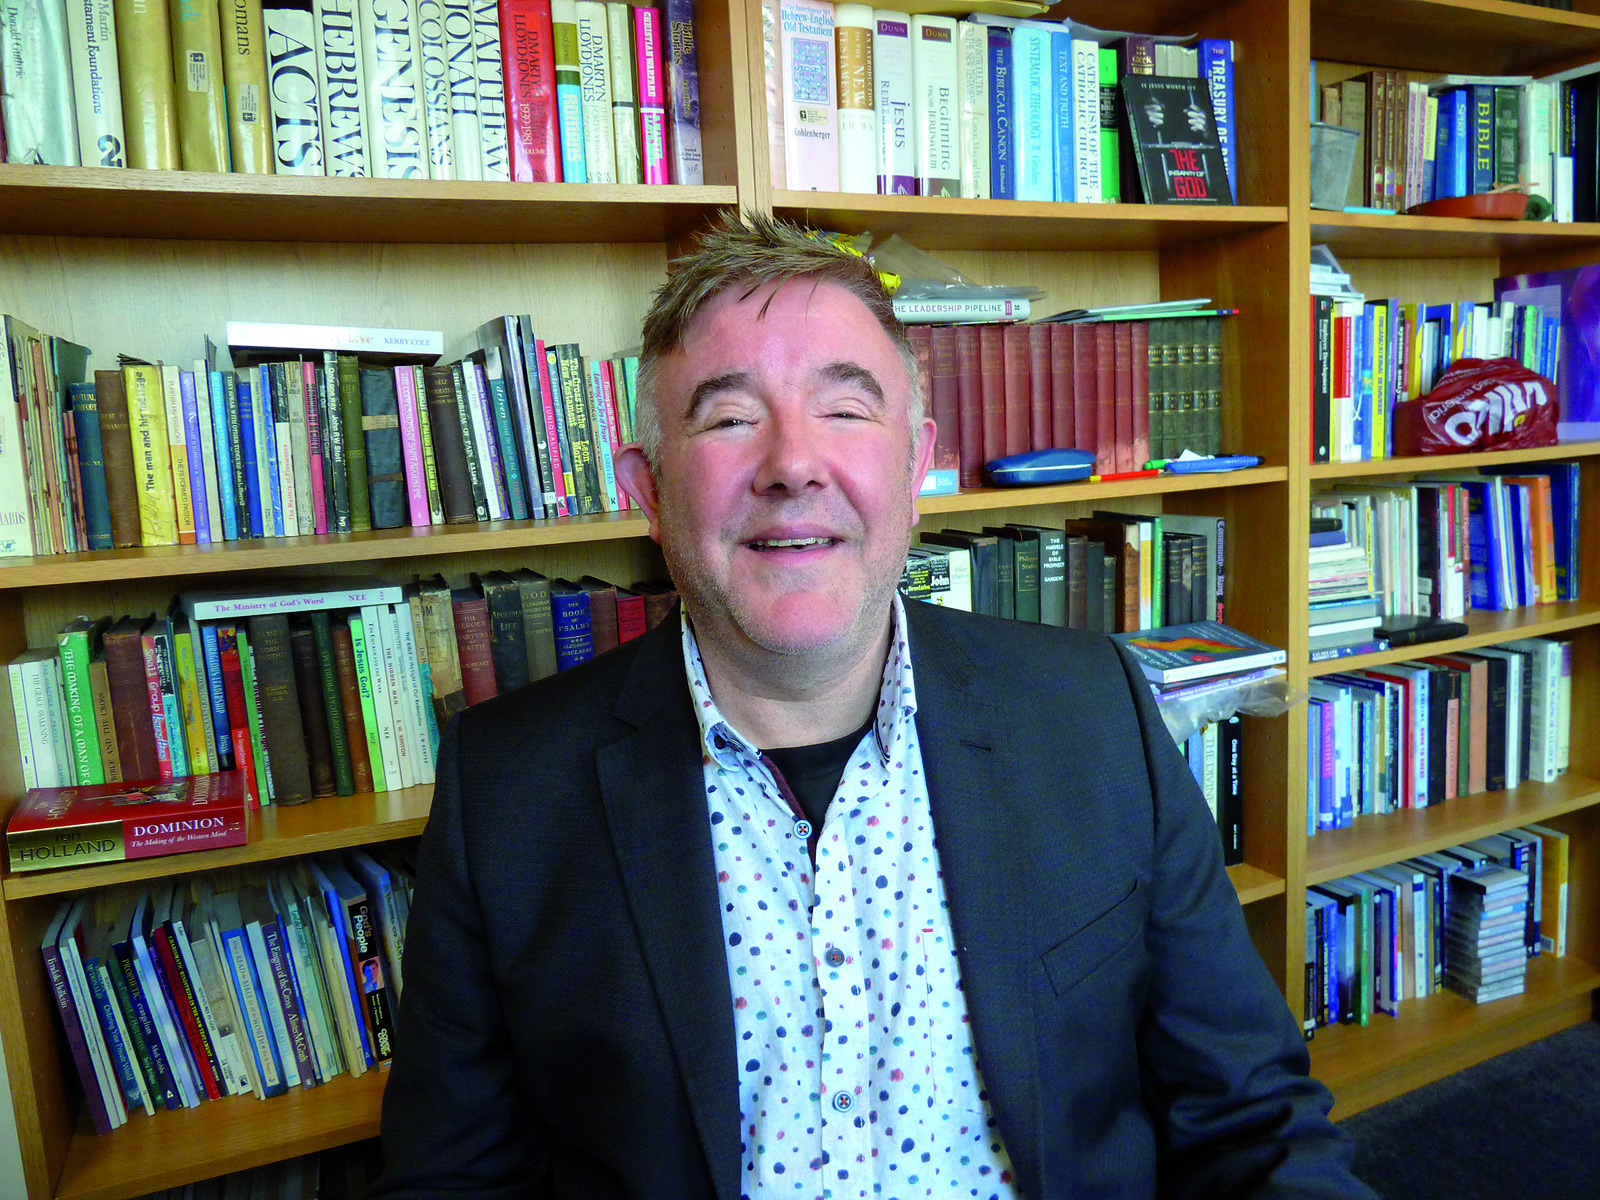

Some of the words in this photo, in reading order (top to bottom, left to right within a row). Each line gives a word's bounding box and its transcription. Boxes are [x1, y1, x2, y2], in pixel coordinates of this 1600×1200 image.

[781, 10, 834, 26] Hebrew-English
[784, 22, 797, 32] Old
[799, 24, 832, 37] Testament
[671, 21, 682, 64] Stories
[526, 31, 543, 99] D.MARTYN
[592, 35, 606, 102] D.MARTYN
[839, 30, 851, 104] TESTAMENT
[1030, 36, 1040, 90] SYSTEMATIC
[1059, 51, 1068, 74] TEXT
[88, 45, 103, 114] Foundations
[418, 0, 452, 166] COLOSSIANS
[853, 65, 865, 104] NEW
[996, 66, 1007, 115] BIBLICAL
[1060, 75, 1068, 96] AND
[1077, 51, 1087, 128] CATHOLIC
[1212, 60, 1227, 123] TREASURY
[268, 25, 322, 168] ACTS
[1087, 53, 1097, 135] CATECHISM
[1030, 92, 1040, 140] THEOLOGY
[1060, 97, 1069, 129] TRUTH
[997, 117, 1008, 161] CANON
[1089, 138, 1098, 155] OF
[1477, 102, 1490, 170] BIBLE
[97, 134, 123, 168] 2
[1078, 132, 1088, 187] CHURCH
[1169, 149, 1200, 170] THE
[1090, 156, 1099, 189] THE
[1174, 177, 1207, 197] GOD
[909, 304, 962, 313] LEADERSHIP
[965, 304, 1002, 312] PIPELINE
[411, 338, 430, 346] COLE
[1321, 319, 1329, 349] Employee
[1396, 326, 1404, 365] systems
[560, 359, 570, 378] New
[570, 358, 579, 375] The
[1321, 352, 1329, 394] Development
[572, 377, 582, 401] Cross
[455, 390, 466, 424] PROBLEM
[496, 386, 506, 418] driven
[563, 380, 576, 427] Testament
[576, 402, 583, 413] in
[462, 427, 469, 438] OF
[578, 413, 587, 429] the
[141, 430, 151, 448] and
[401, 386, 414, 430] CONFESSIONS
[411, 461, 422, 499] AUGUSTINE
[545, 405, 560, 469] (UN)QUALIFIED
[600, 425, 608, 443] Prayer
[144, 451, 154, 470] man
[334, 445, 342, 463] Stott
[464, 440, 473, 458] PAIN
[572, 442, 584, 472] Morris
[581, 440, 590, 463] Leon
[146, 473, 156, 492] The
[178, 470, 187, 503] REFORMED
[183, 503, 191, 526] PASTOR
[931, 576, 949, 586] John
[1216, 575, 1225, 596] King
[214, 604, 232, 612] The
[234, 601, 267, 611] Ministry
[269, 600, 278, 609] of
[279, 598, 301, 607] God's
[303, 597, 325, 605] Word
[348, 593, 367, 601] NEE
[499, 622, 518, 631] LIFE
[562, 610, 585, 618] BOOK
[558, 622, 590, 632] PSALMS
[355, 637, 363, 647] Is
[145, 648, 155, 677] Small
[207, 635, 218, 676] COURAGEOUS
[356, 649, 365, 674] Jesus
[31, 673, 39, 686] THE
[321, 650, 335, 692] PROBLEMS
[387, 662, 396, 687] HIDDEN
[33, 688, 42, 707] GRACE
[149, 681, 161, 712] Group
[211, 677, 225, 714] LEADERSHIP
[360, 676, 370, 698] God?
[37, 709, 48, 745] AWAKENING
[67, 672, 82, 712] MAKING
[77, 738, 88, 763] MAN
[329, 695, 345, 756] PHILOSOPHICAL
[1205, 737, 1215, 760] THE
[55, 832, 82, 842] TOM
[133, 816, 225, 838] DOMINION
[144, 837, 169, 846] Making
[186, 832, 210, 841] Western
[210, 829, 227, 838] Mind
[20, 838, 116, 862] HOLLAND
[359, 905, 372, 937] God's
[266, 932, 279, 947] The
[353, 915, 367, 953] People
[270, 946, 284, 971] Enigma
[46, 955, 59, 983] Tyndale
[54, 982, 69, 1009] Bulletin
[277, 971, 287, 979] of
[279, 978, 287, 989] the
[122, 958, 141, 1000] PROPHETIC
[136, 1003, 153, 1035] evangelism
[167, 935, 183, 970] CHARISMATIC
[178, 970, 193, 1000] MINISTRIES
[196, 1028, 213, 1058] TESTAMENT
[198, 987, 210, 1012] ADVENTURES
[235, 954, 247, 974] READ
[242, 979, 252, 999] BIBLE
[253, 1018, 266, 1046] WORTH
[282, 987, 293, 1009] Cross
[102, 1004, 116, 1030] Ordering
[288, 1012, 300, 1034] Alister
[111, 1030, 122, 1043] Your
[294, 1033, 308, 1063] McGrath
[115, 1043, 128, 1060] Private
[121, 1060, 134, 1082] World
